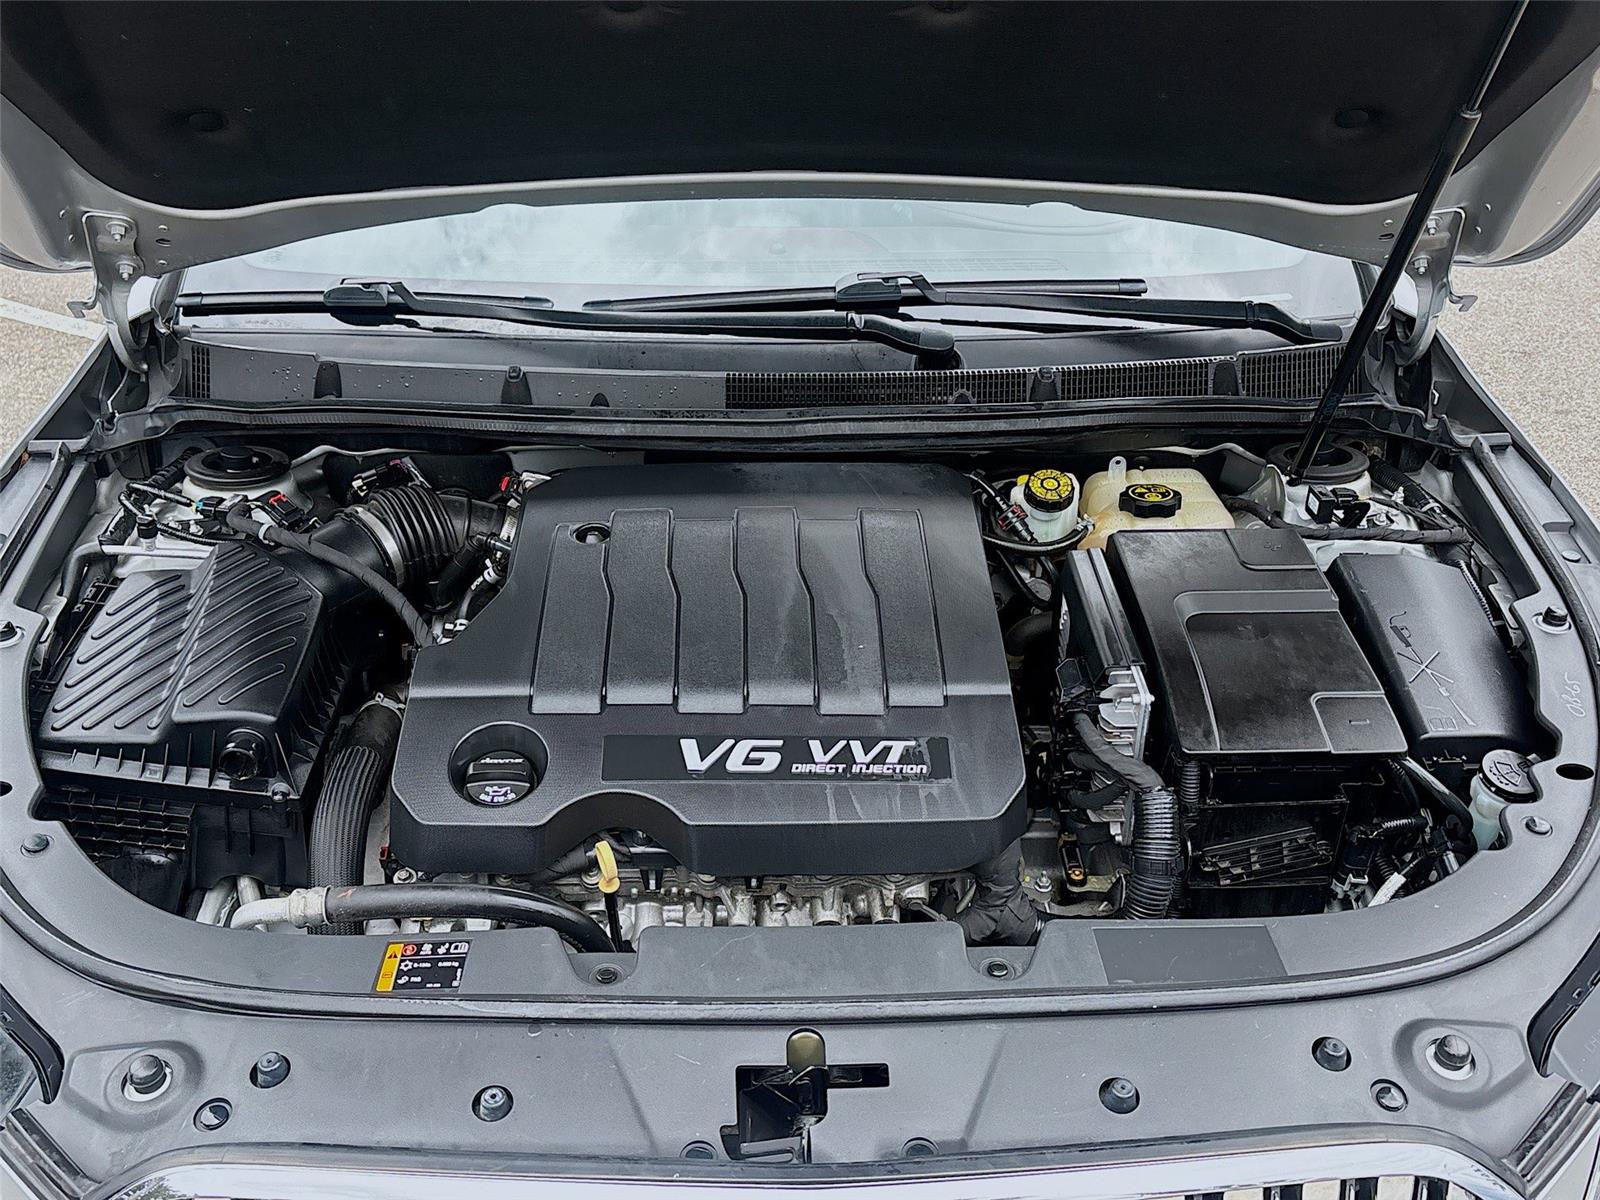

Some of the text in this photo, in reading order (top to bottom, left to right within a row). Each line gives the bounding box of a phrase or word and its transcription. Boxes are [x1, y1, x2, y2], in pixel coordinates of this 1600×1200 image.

[679, 738, 916, 774] V6 VVT
[791, 763, 928, 775] DIRECT INJECTION
